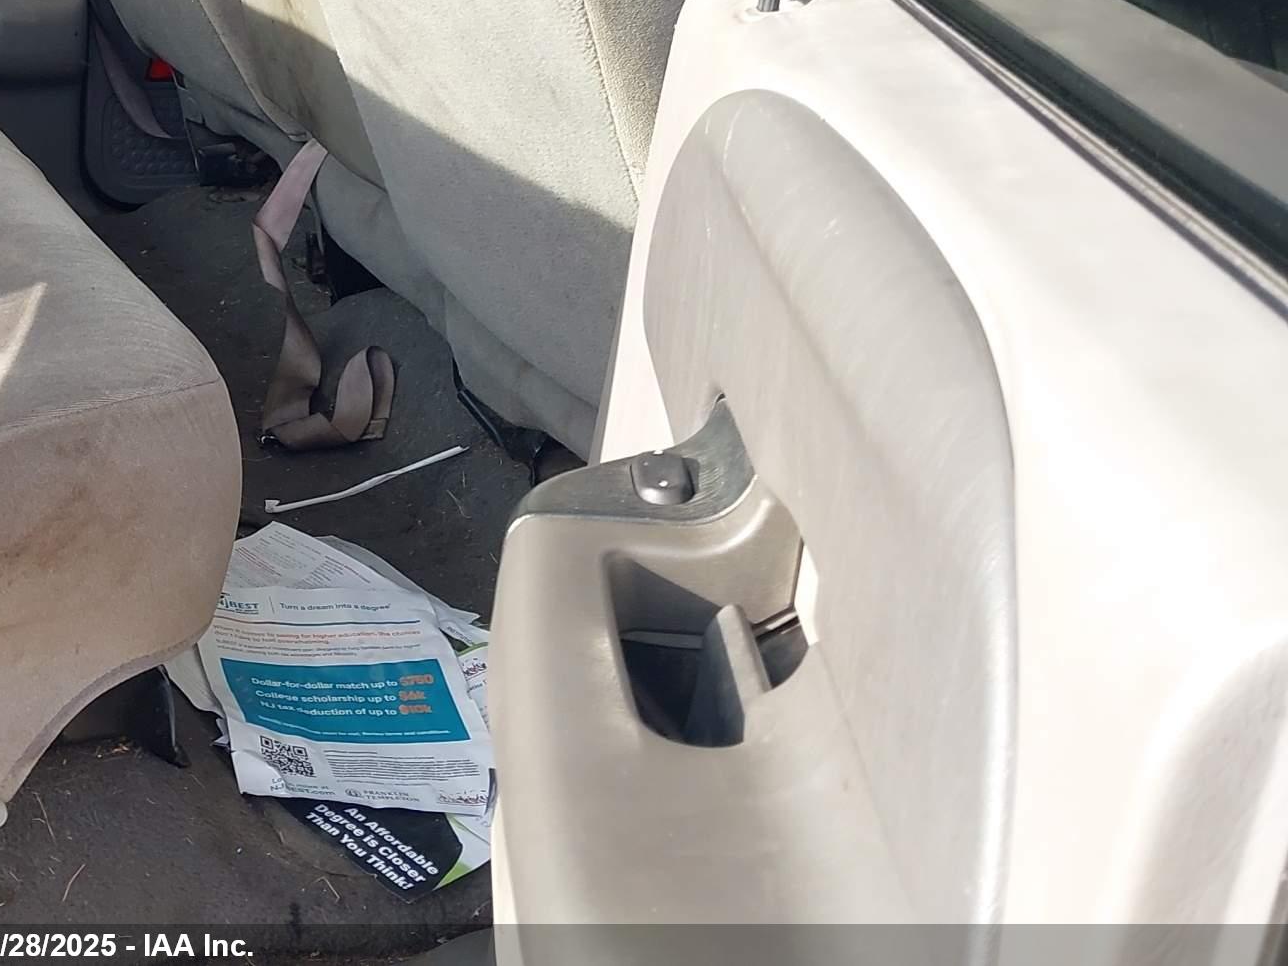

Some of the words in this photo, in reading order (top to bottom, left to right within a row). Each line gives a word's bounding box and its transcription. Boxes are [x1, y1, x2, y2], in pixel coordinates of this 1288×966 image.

[279, 602, 299, 611] Turn
[307, 603, 334, 611] dream
[335, 602, 352, 610] into
[251, 677, 334, 690] Dollar-for-dollar
[336, 681, 369, 689] match
[370, 681, 385, 690] up
[386, 679, 398, 687] to
[255, 690, 299, 702] College
[301, 693, 366, 703] scholarship
[367, 694, 383, 704] up
[384, 693, 397, 702] to
[277, 703, 295, 711] tax
[297, 706, 354, 716] deduction
[354, 707, 367, 715] of
[369, 708, 383, 717] up
[384, 707, 397, 716] to
[363, 789, 409, 797] FRANKLIN
[314, 803, 365, 837] Degree
[362, 834, 379, 848] is
[378, 846, 427, 883] Closer
[344, 808, 367, 822] An
[364, 821, 439, 875] Affordable
[306, 812, 341, 837] Than
[340, 833, 368, 858] You
[366, 854, 415, 891] Think!
